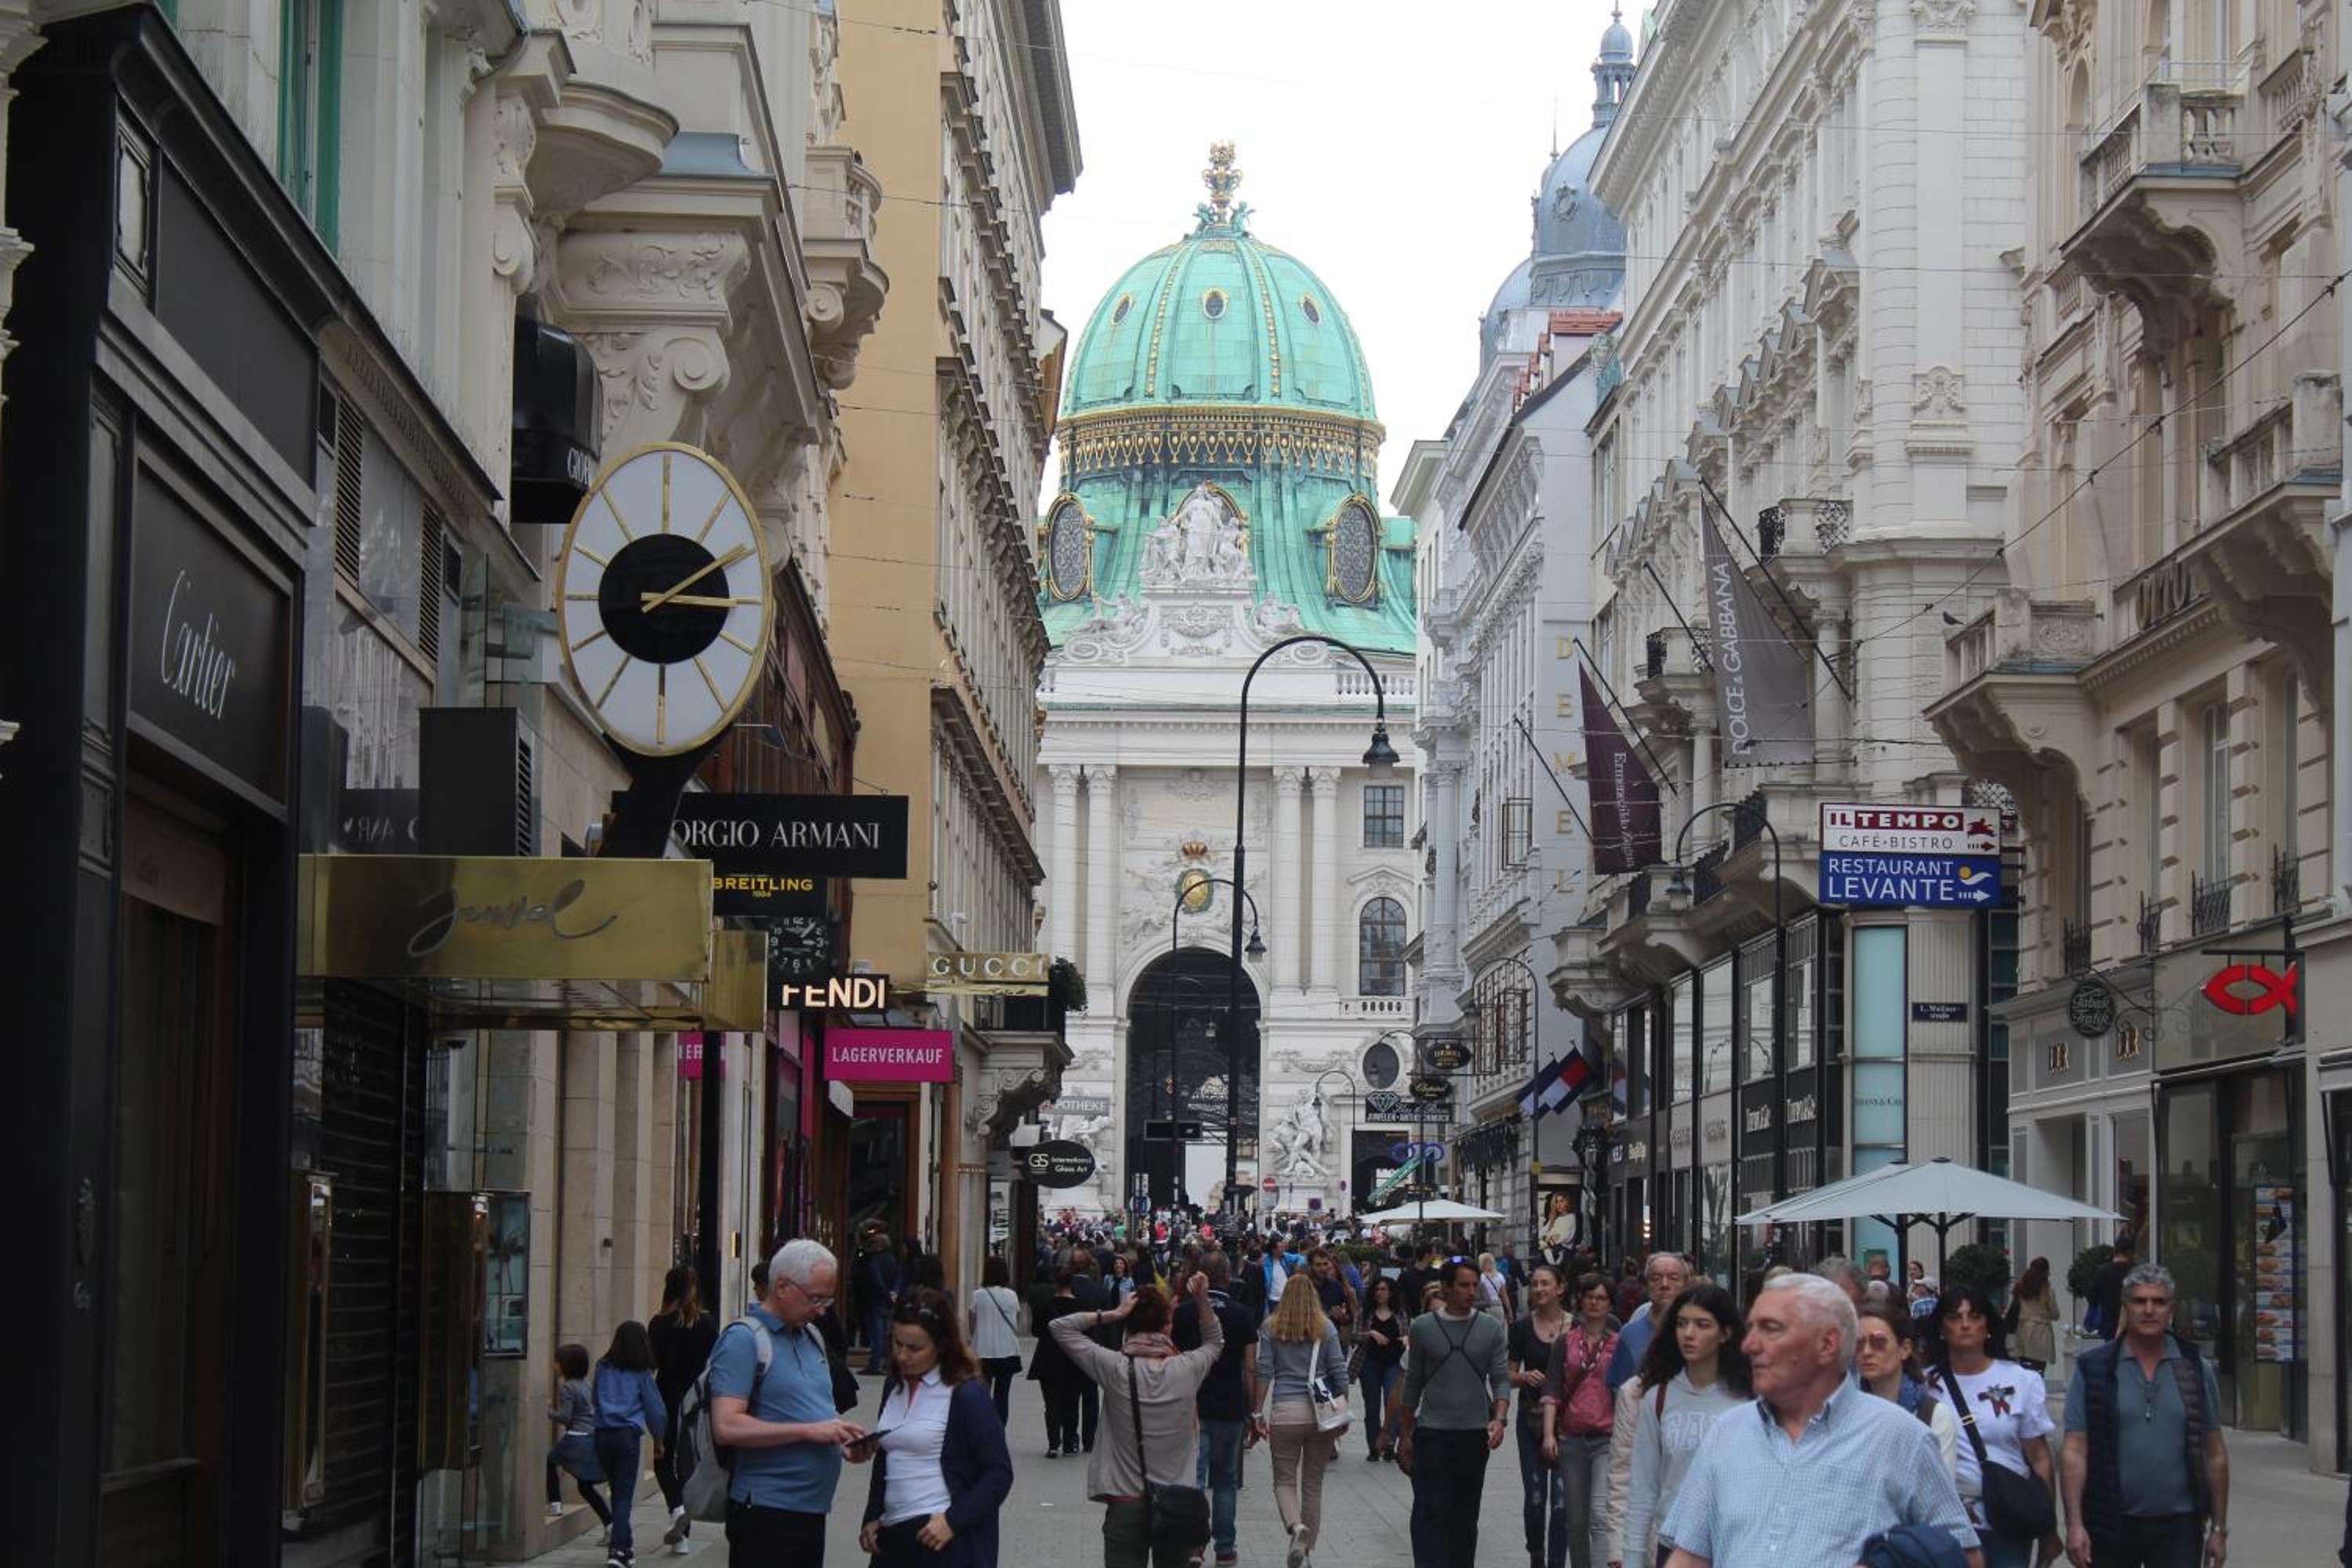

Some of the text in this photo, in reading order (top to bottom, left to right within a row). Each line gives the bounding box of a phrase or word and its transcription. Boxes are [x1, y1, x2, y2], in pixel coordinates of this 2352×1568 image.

[1712, 562, 1742, 672] GABBANA
[162, 570, 234, 720] Cartier
[1726, 687, 1751, 755] DOLCE
[1555, 635, 1577, 894] DEMEL
[672, 818, 879, 848] ORGIO ARMANI
[1857, 812, 1959, 829] TEMPO
[1829, 858, 1954, 876] RESTAURANT
[712, 877, 813, 891] BREITLING
[1829, 877, 1955, 901] LEVANTE
[933, 955, 1044, 976] GUCCI
[782, 978, 885, 1009] FENDI
[832, 1047, 943, 1064] LAGERVERKAUF
[1054, 1098, 1105, 1112] POTHEKE
[1663, 1410, 1711, 1456] GA
